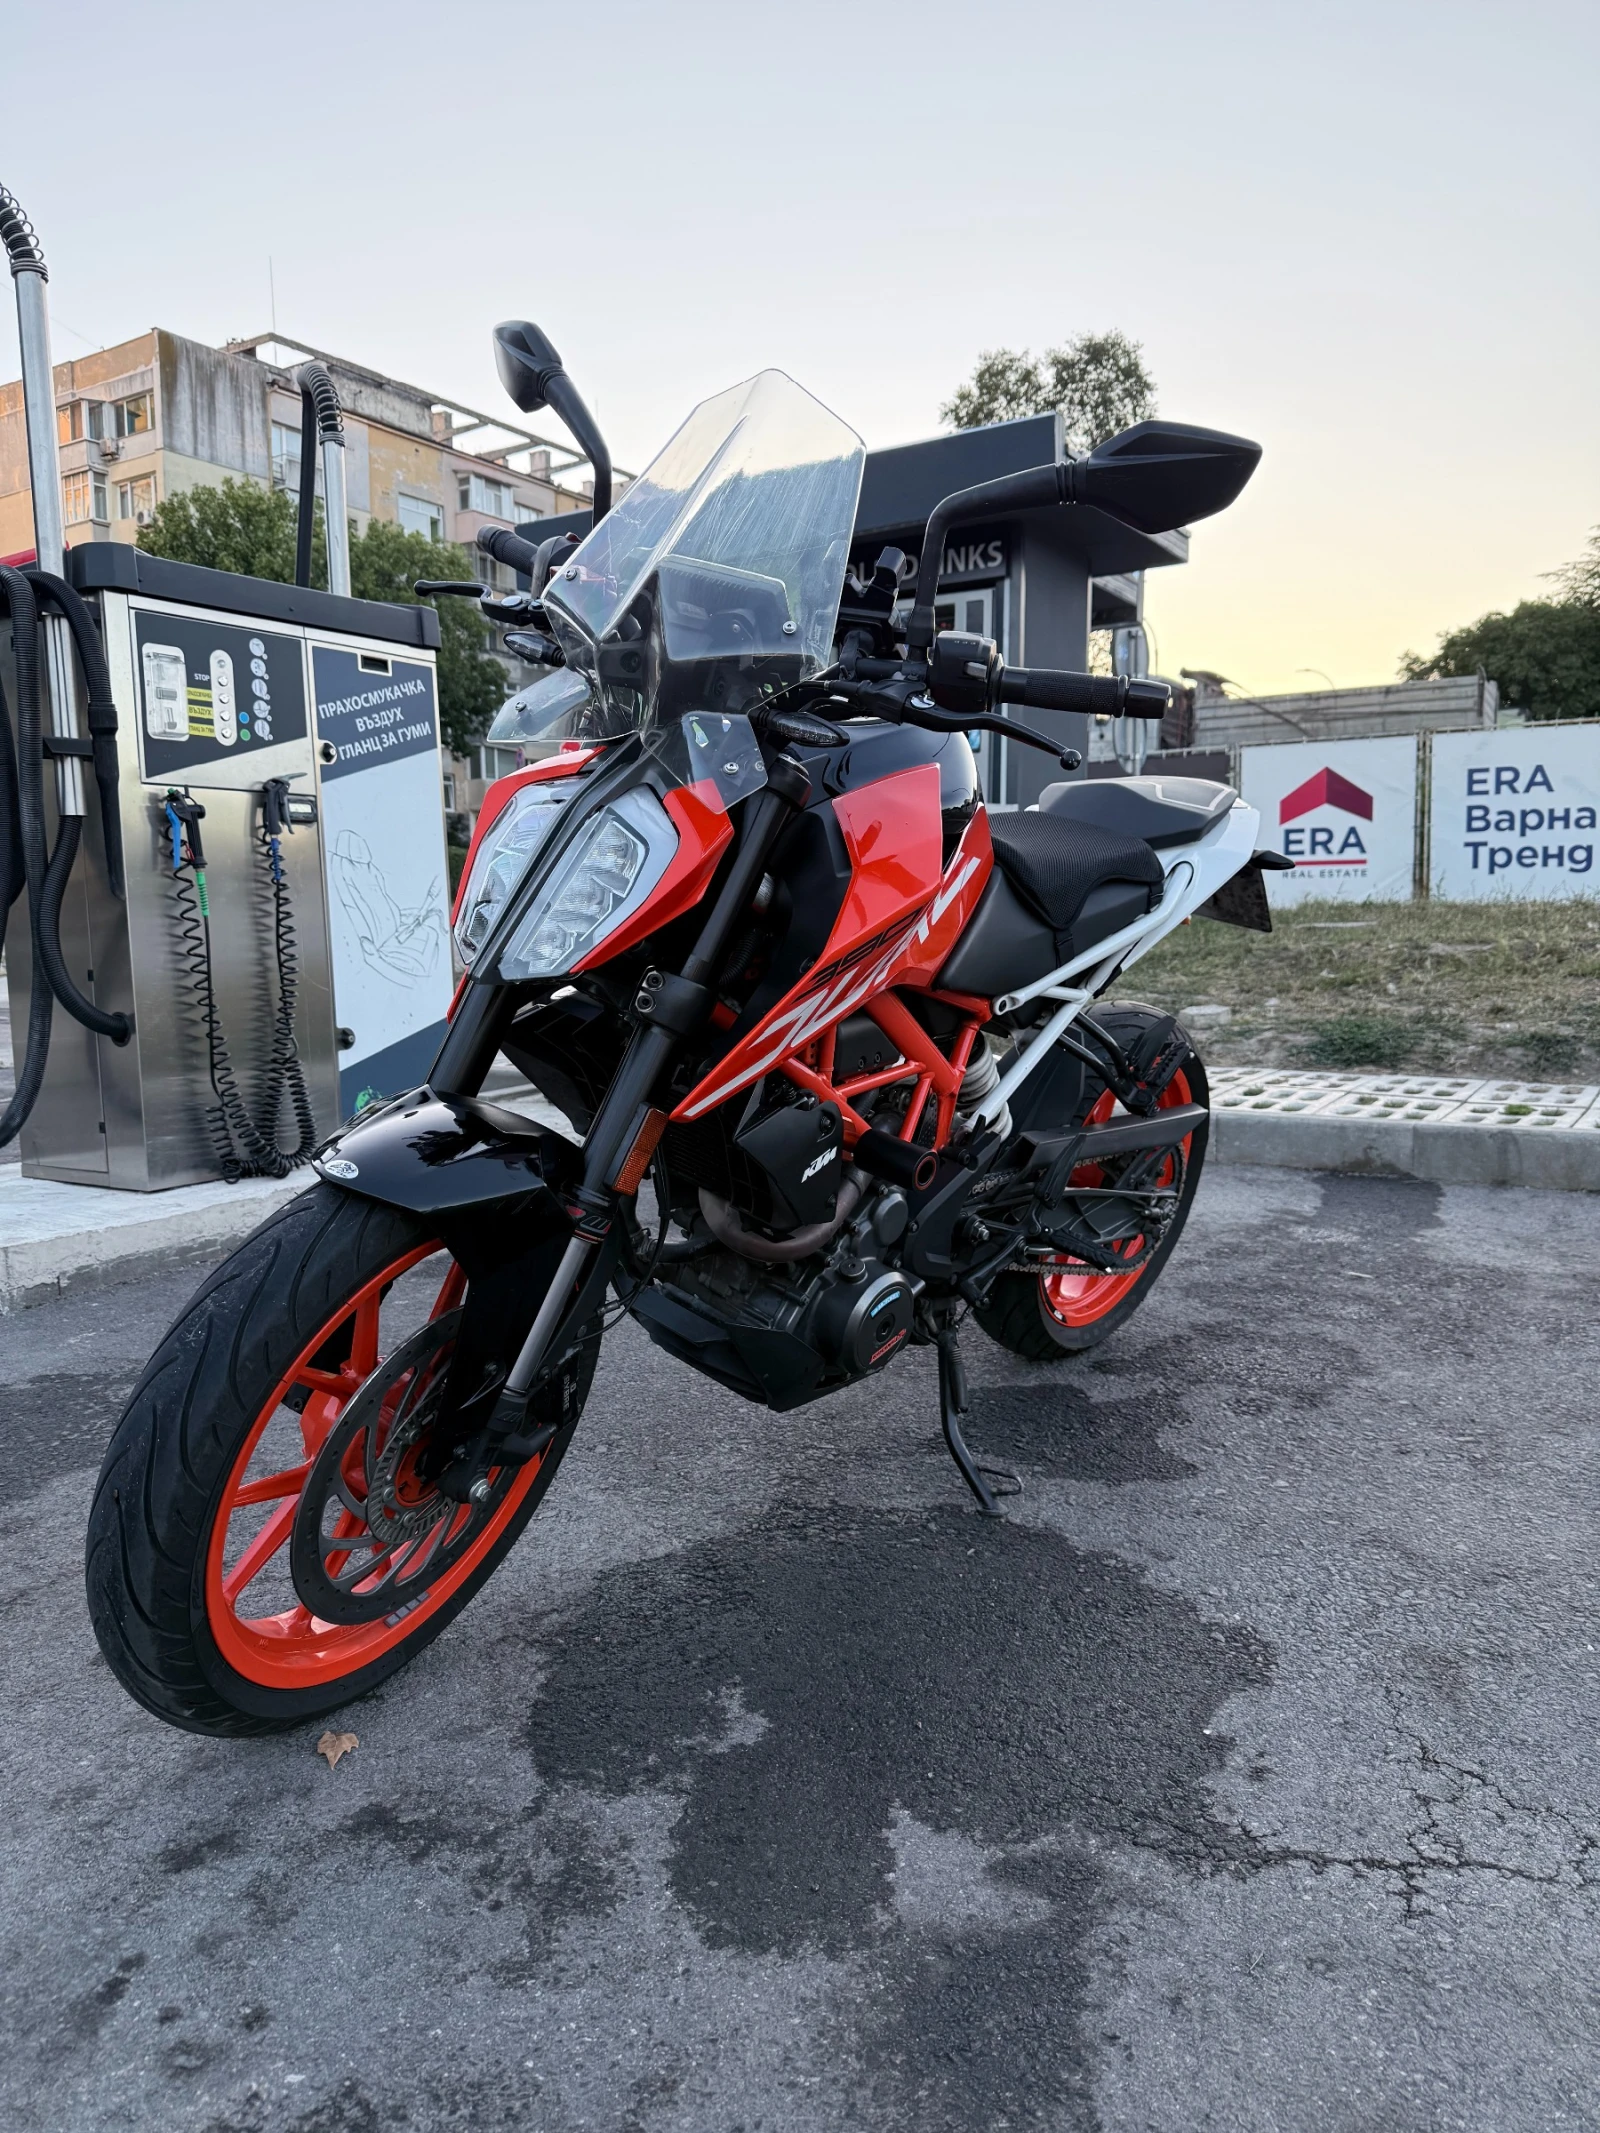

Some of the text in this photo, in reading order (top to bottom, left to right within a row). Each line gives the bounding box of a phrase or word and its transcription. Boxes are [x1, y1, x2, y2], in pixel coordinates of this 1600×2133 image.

[194, 673, 210, 682] STOP
[318, 679, 426, 719] ПРАХОСМУКАЧКА
[355, 707, 405, 732] ВЪЗДУХ
[338, 721, 432, 760] ГЛАНЦ ЗА ГУМИ
[1466, 764, 1555, 796] ERA
[1465, 804, 1597, 837] Варна
[1284, 826, 1367, 856] ERA
[1282, 868, 1368, 879] REAL ESTATE
[1463, 841, 1593, 875] Тренд
[801, 1146, 837, 1183] KTM
